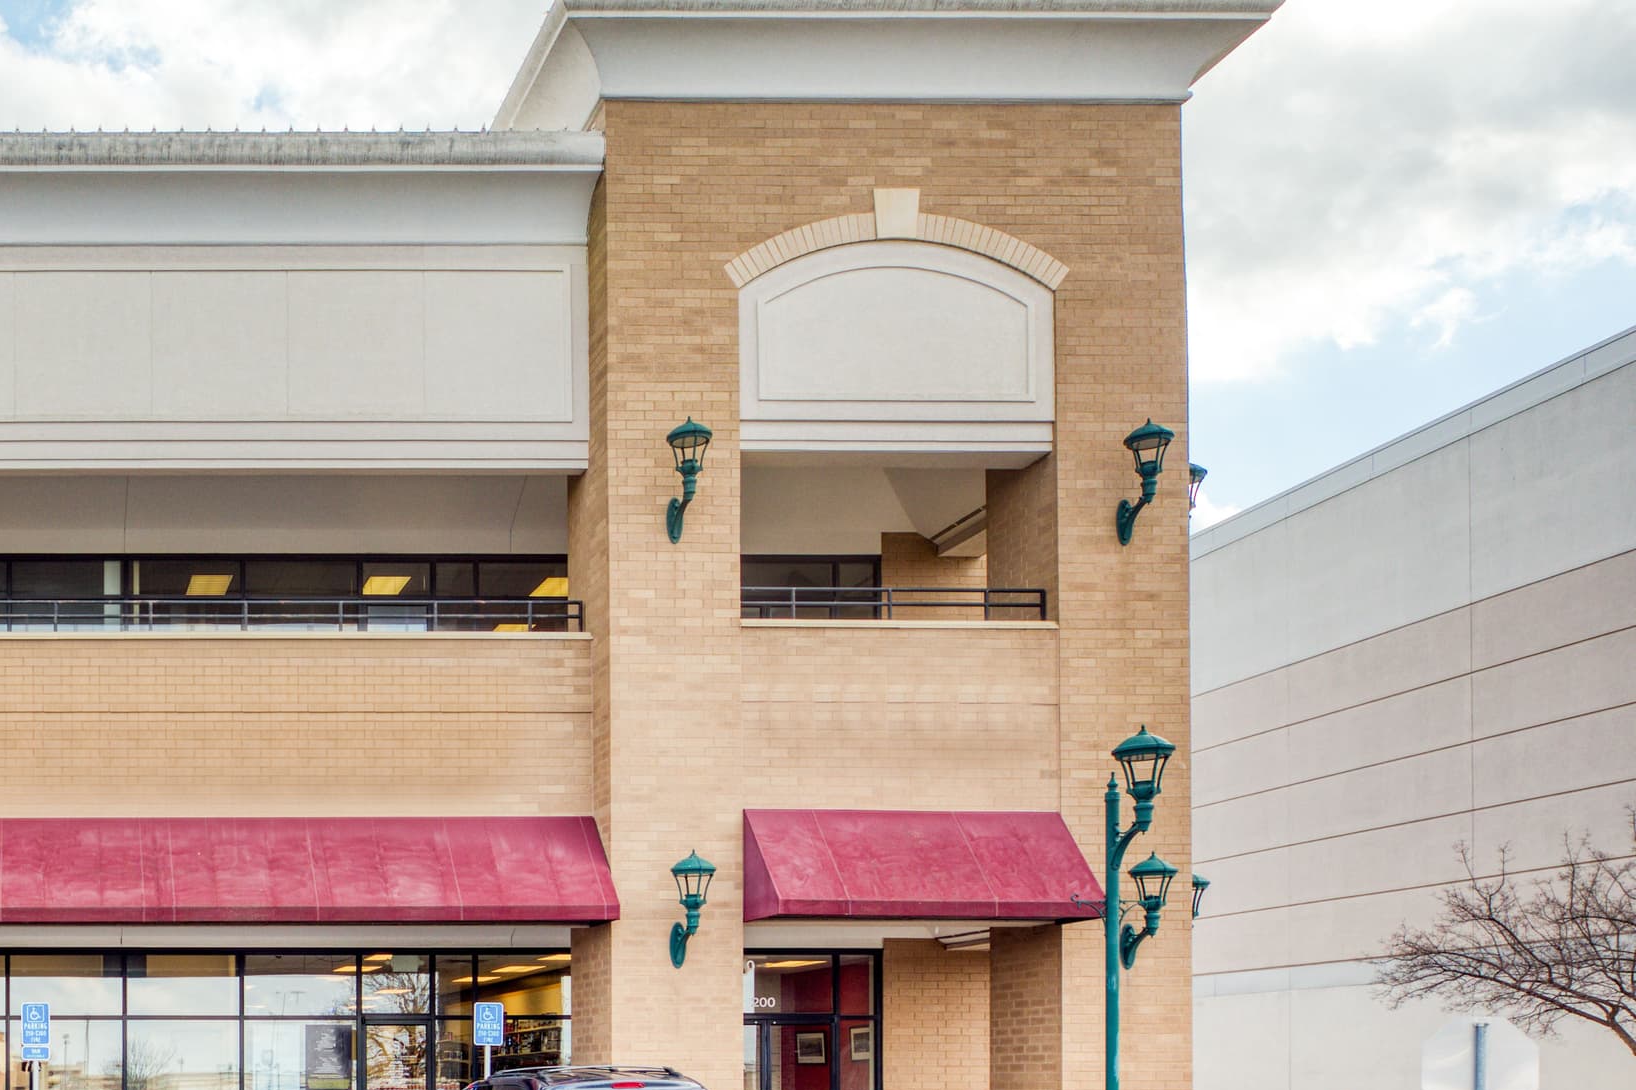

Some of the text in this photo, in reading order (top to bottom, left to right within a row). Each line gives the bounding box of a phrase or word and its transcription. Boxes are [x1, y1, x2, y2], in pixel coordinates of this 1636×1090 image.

[754, 997, 776, 1008] 200
[24, 1022, 48, 1030] PARKING
[476, 1022, 501, 1030] PARKING
